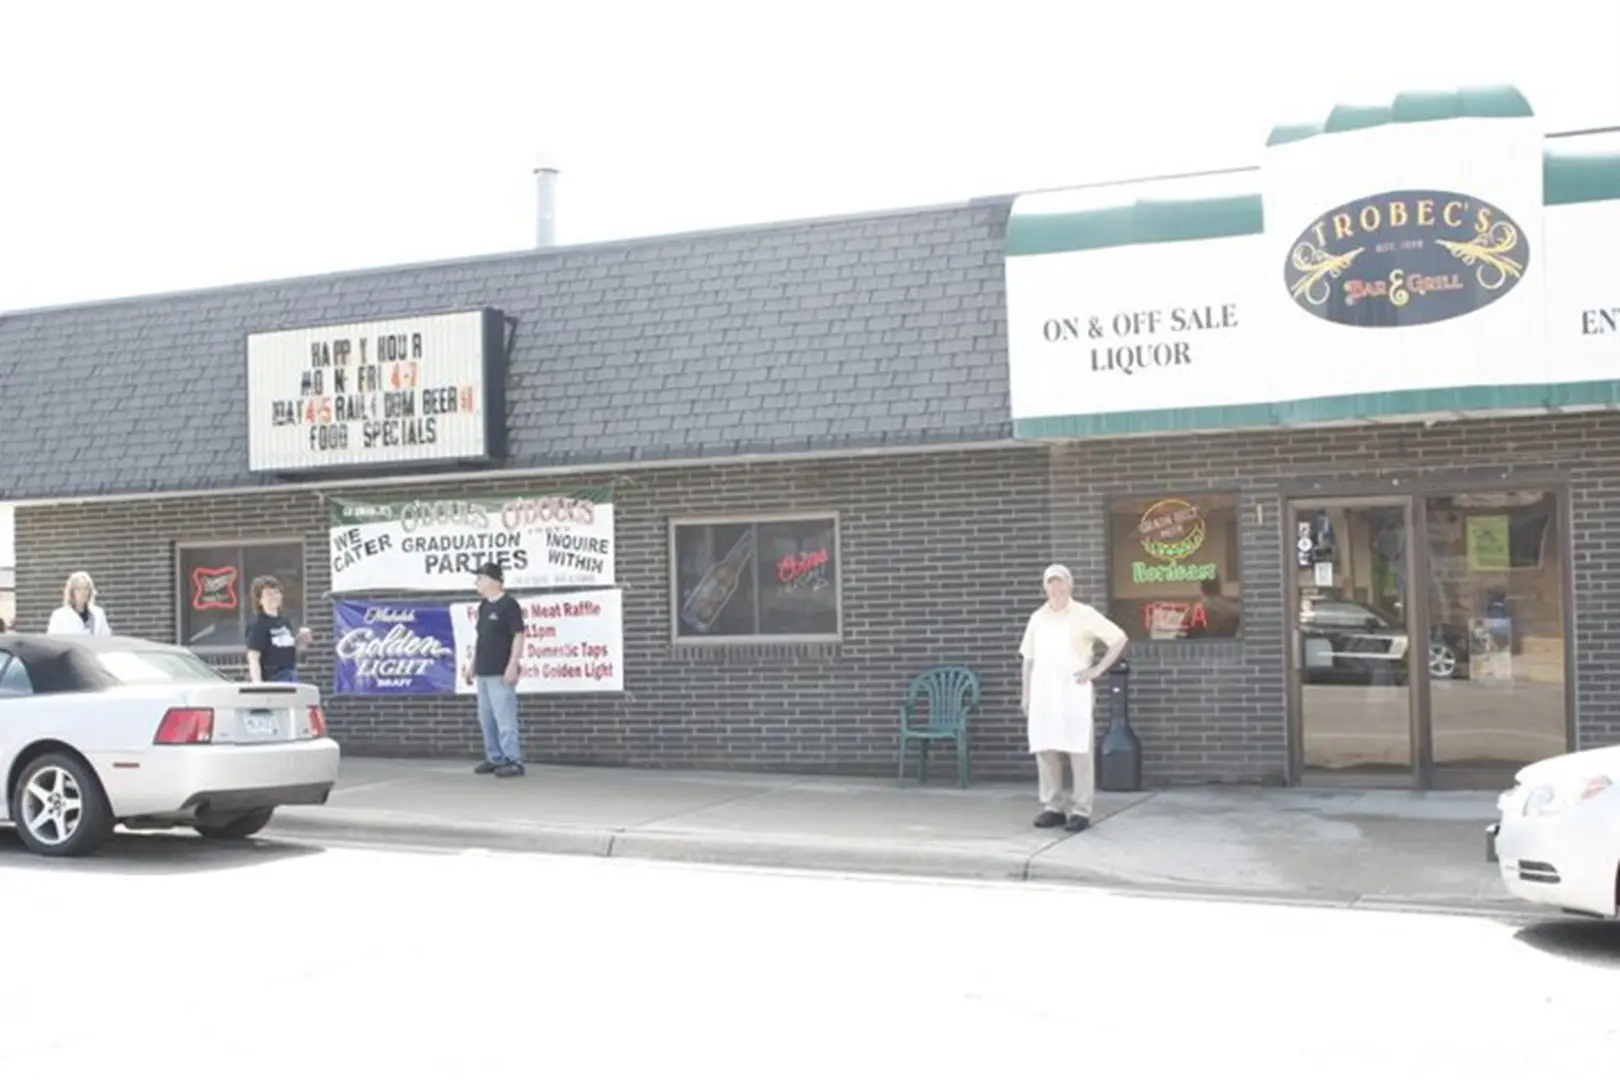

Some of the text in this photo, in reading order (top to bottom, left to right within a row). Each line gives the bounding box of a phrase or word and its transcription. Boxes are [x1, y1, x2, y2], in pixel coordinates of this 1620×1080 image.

[1311, 199, 1494, 247] TROBEC'S
[1343, 268, 1463, 306] BAR & GRILL
[1043, 303, 1239, 343] ON & OFF SALE
[378, 332, 422, 360] HOUR
[1090, 342, 1192, 376] LIQUOR
[422, 386, 458, 414] BEER
[310, 418, 437, 450] FOOD SPECIALS
[333, 528, 362, 552] WE
[401, 532, 521, 553] GRADUATION
[546, 532, 609, 554] INQUIRE
[333, 534, 393, 573] CATER
[424, 550, 529, 575] PARTIES
[547, 549, 604, 573] WITHIN
[531, 603, 562, 618] Meat
[564, 601, 601, 615] Raffle
[336, 623, 452, 658] Golden
[581, 643, 609, 658] Taps
[357, 659, 434, 677] LIGHT
[542, 664, 582, 679] Golden
[584, 662, 613, 681] Light
